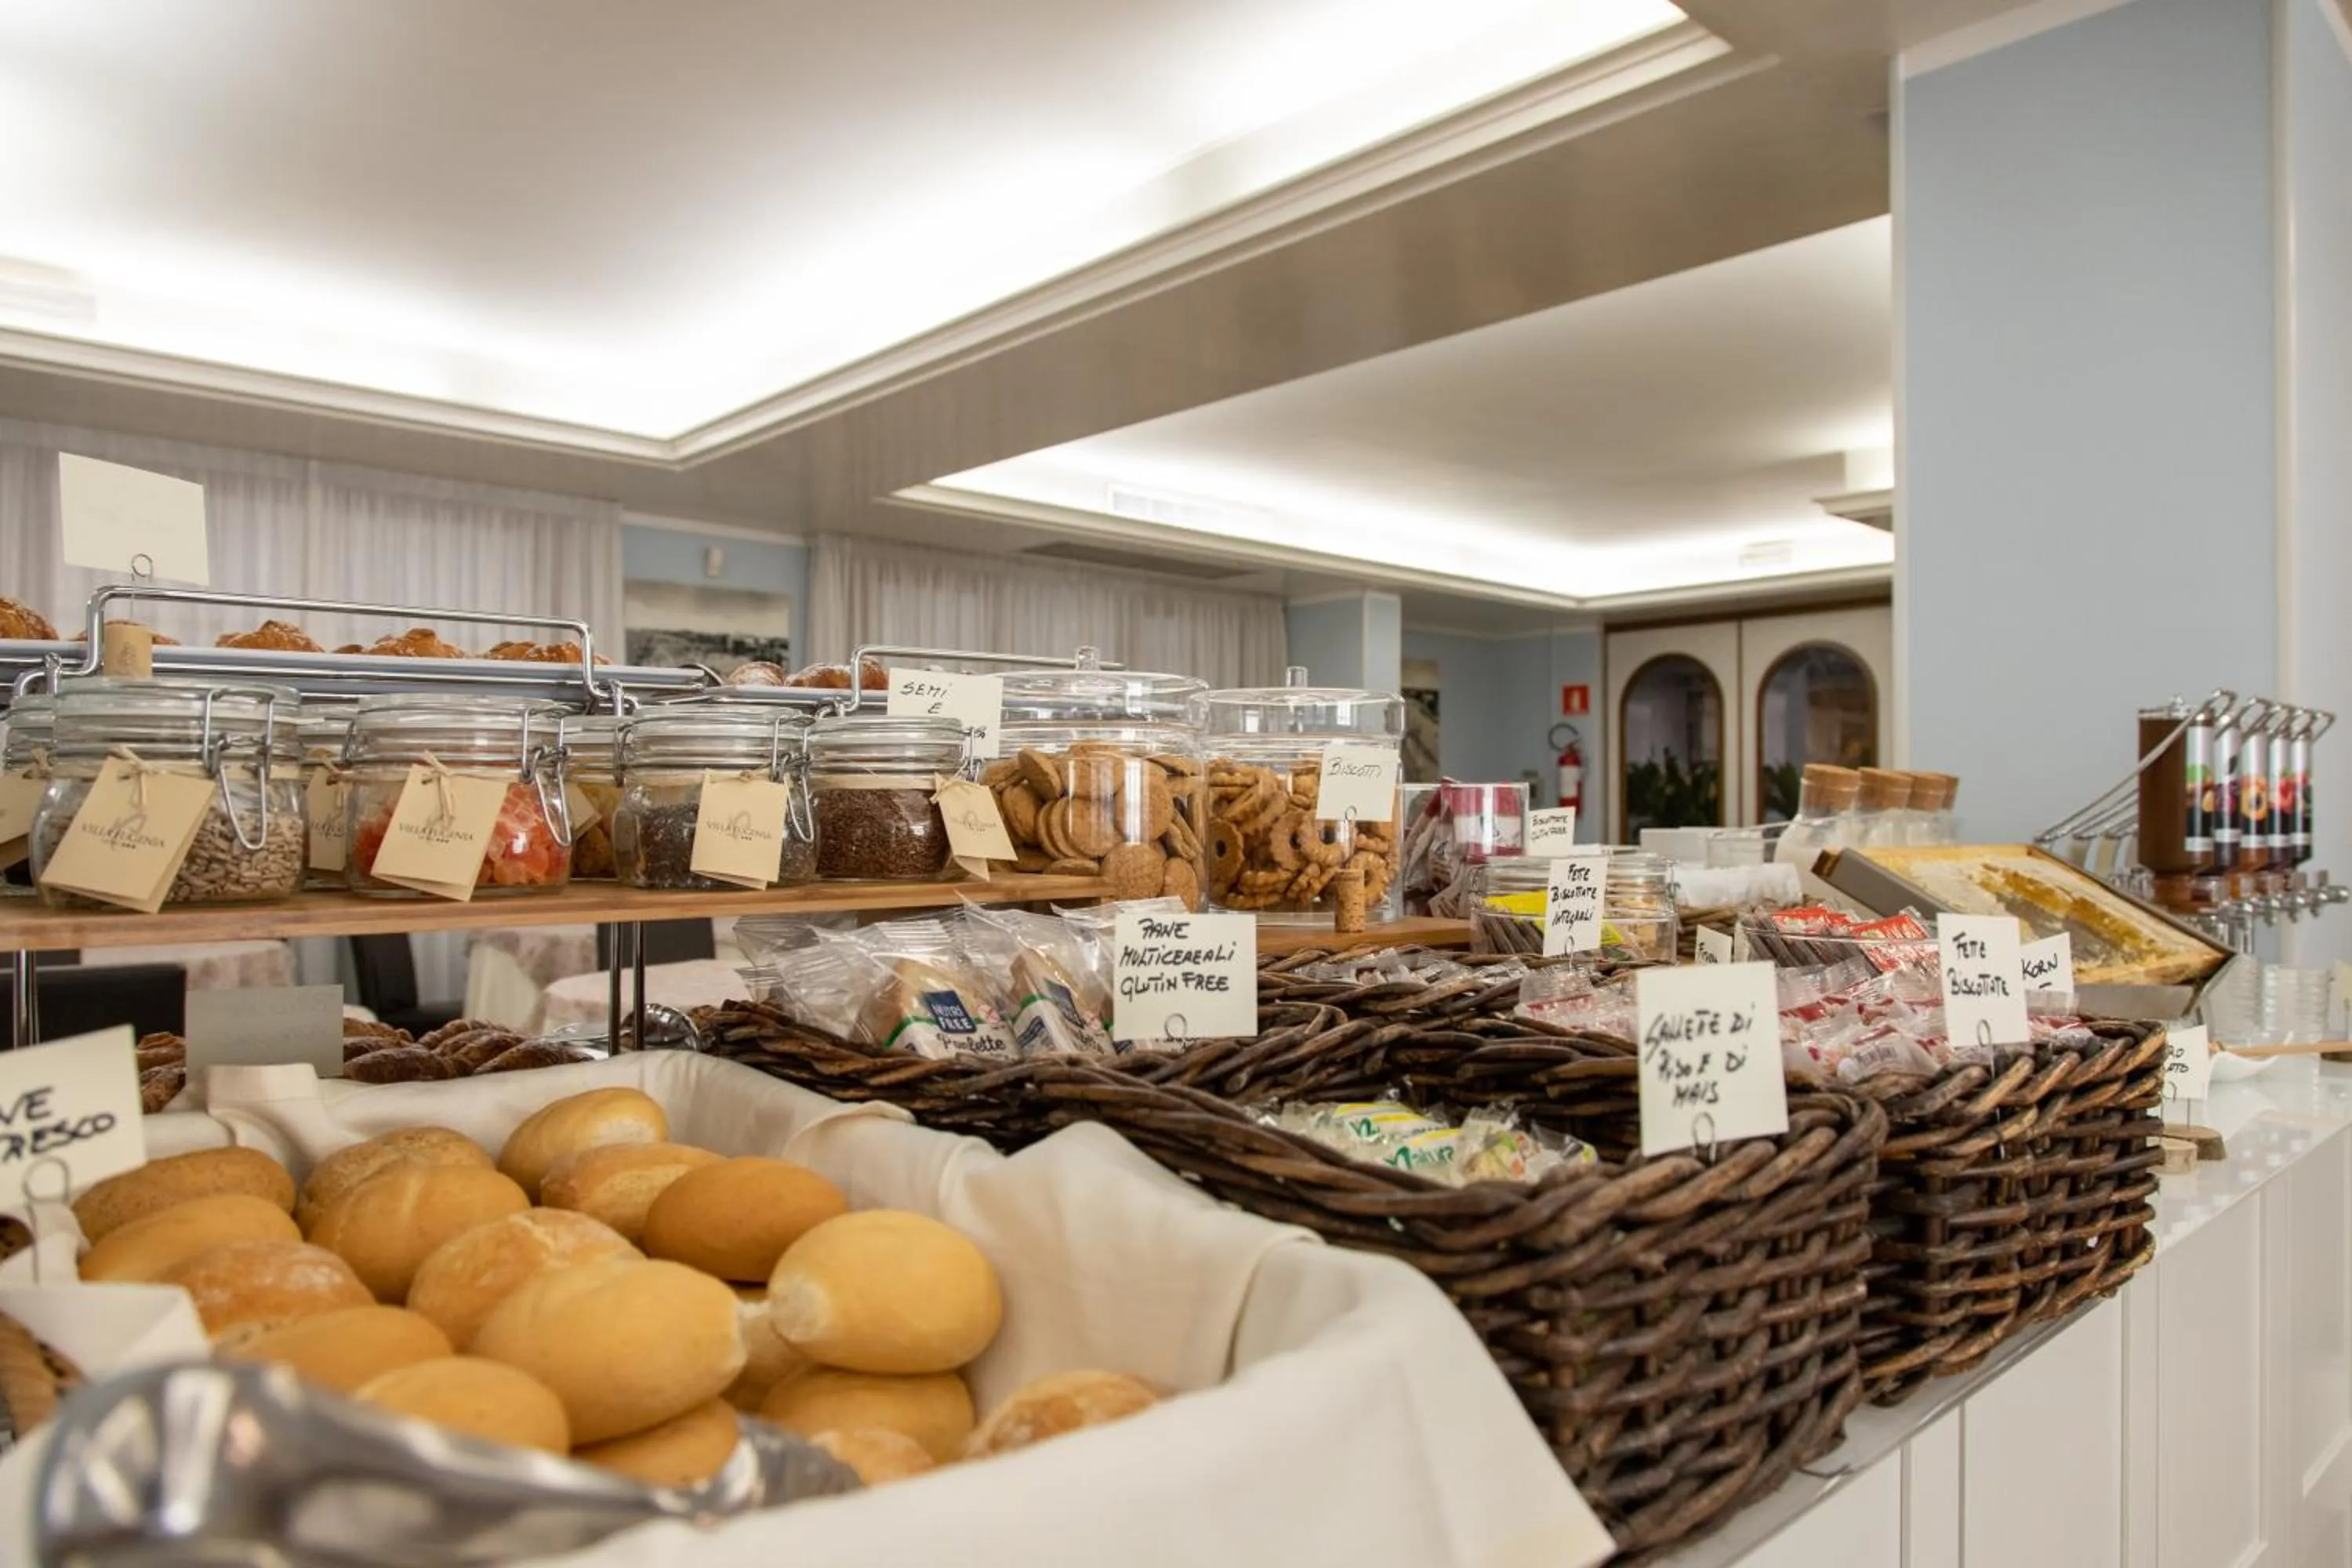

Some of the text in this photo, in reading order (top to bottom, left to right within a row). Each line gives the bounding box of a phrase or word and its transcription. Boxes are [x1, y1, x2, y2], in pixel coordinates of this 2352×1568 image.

[900, 681, 953, 699] SEMI
[927, 702, 942, 714] E
[1138, 918, 1191, 939] PANE
[1119, 941, 1237, 967] MULTICEREALI
[2020, 953, 2059, 980] KORN
[1120, 971, 1229, 1003] GLUTIN FREE
[1730, 1001, 1756, 1033] DI
[1725, 1044, 1748, 1073] DI
[1672, 1080, 1720, 1108] MAIS
